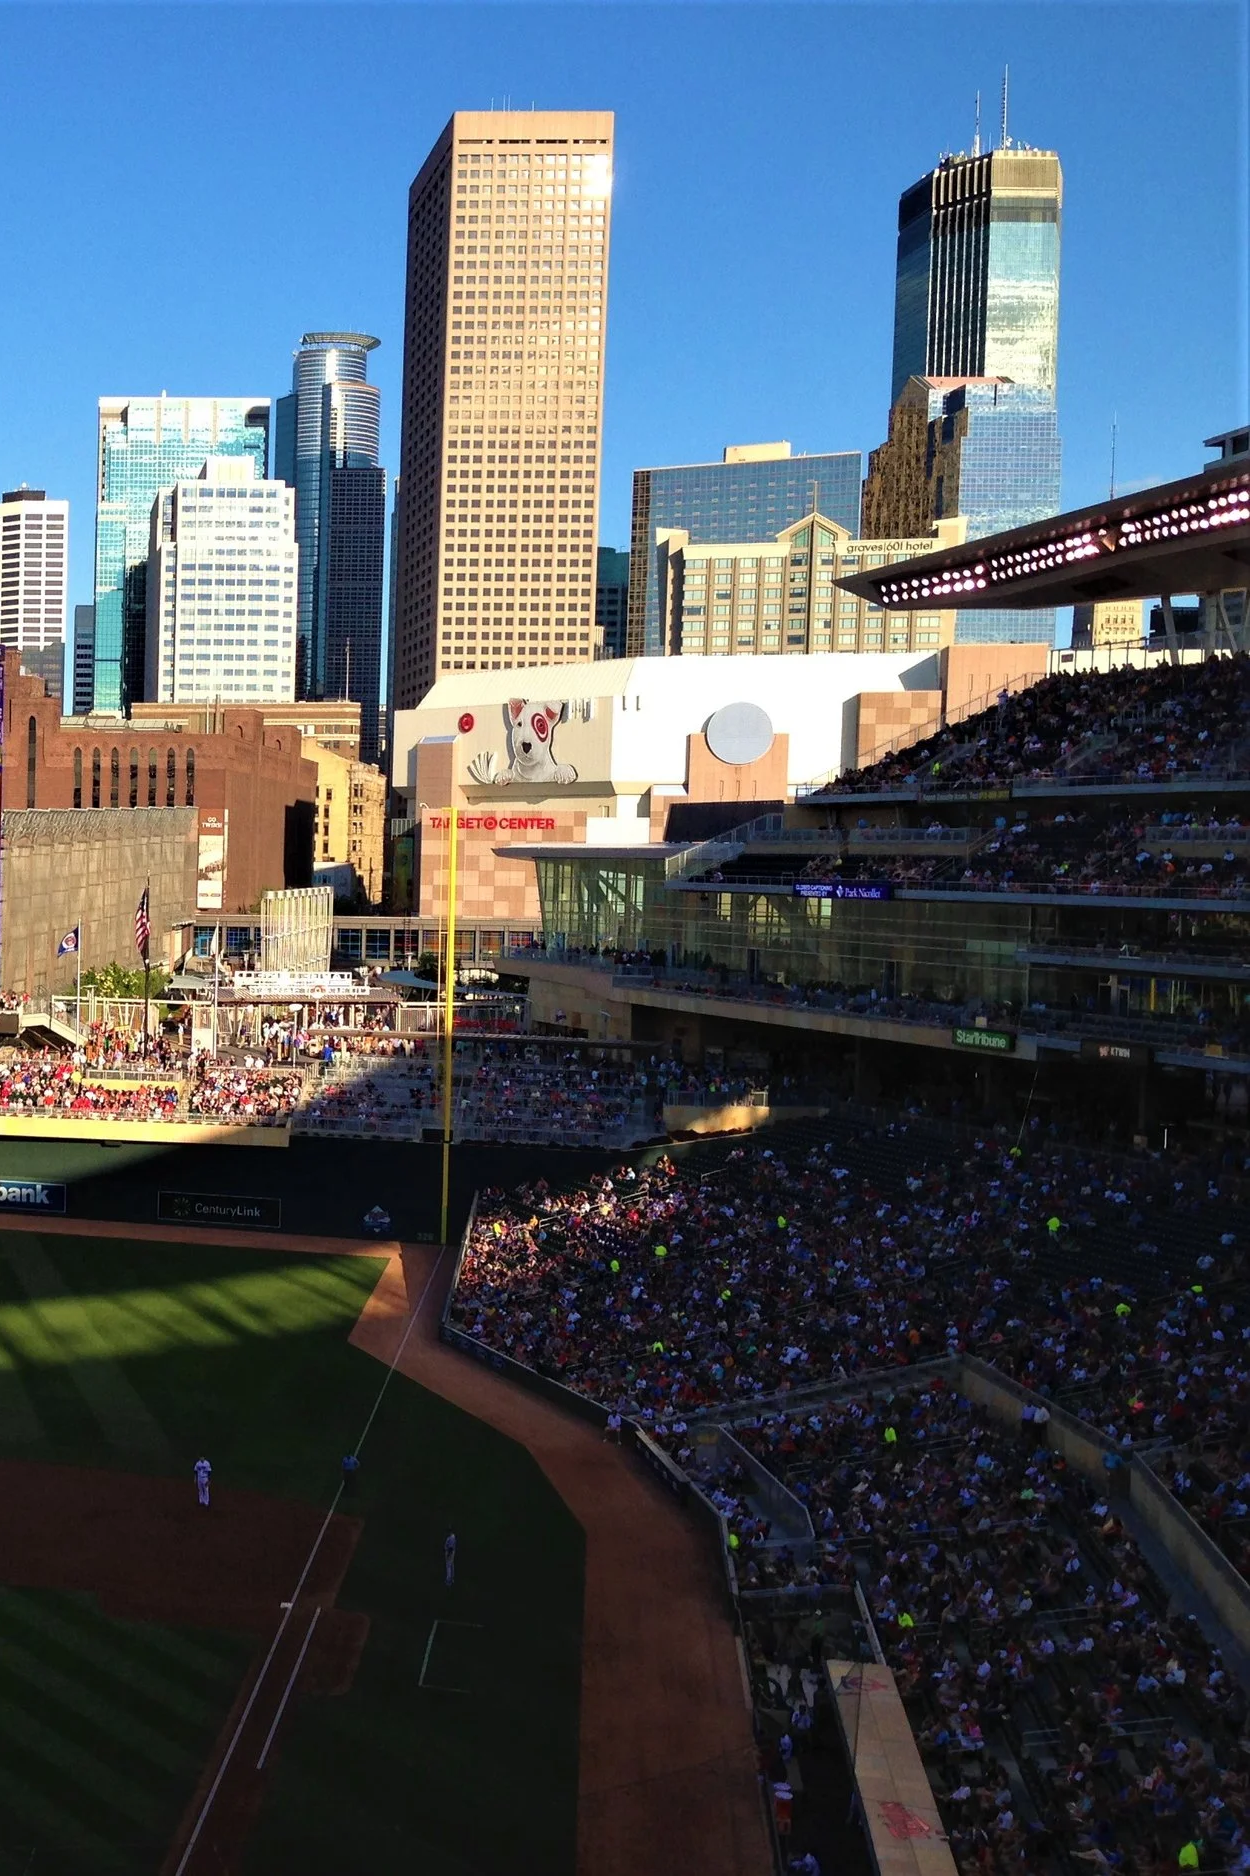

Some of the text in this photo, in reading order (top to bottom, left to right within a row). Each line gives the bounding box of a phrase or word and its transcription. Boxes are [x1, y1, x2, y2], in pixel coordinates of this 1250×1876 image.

[906, 540, 933, 551] hotel
[499, 818, 555, 829] CENTER
[845, 888, 858, 897] Park
[956, 1030, 1007, 1048] StarTribune
[195, 1202, 261, 1218] CenturyLink
